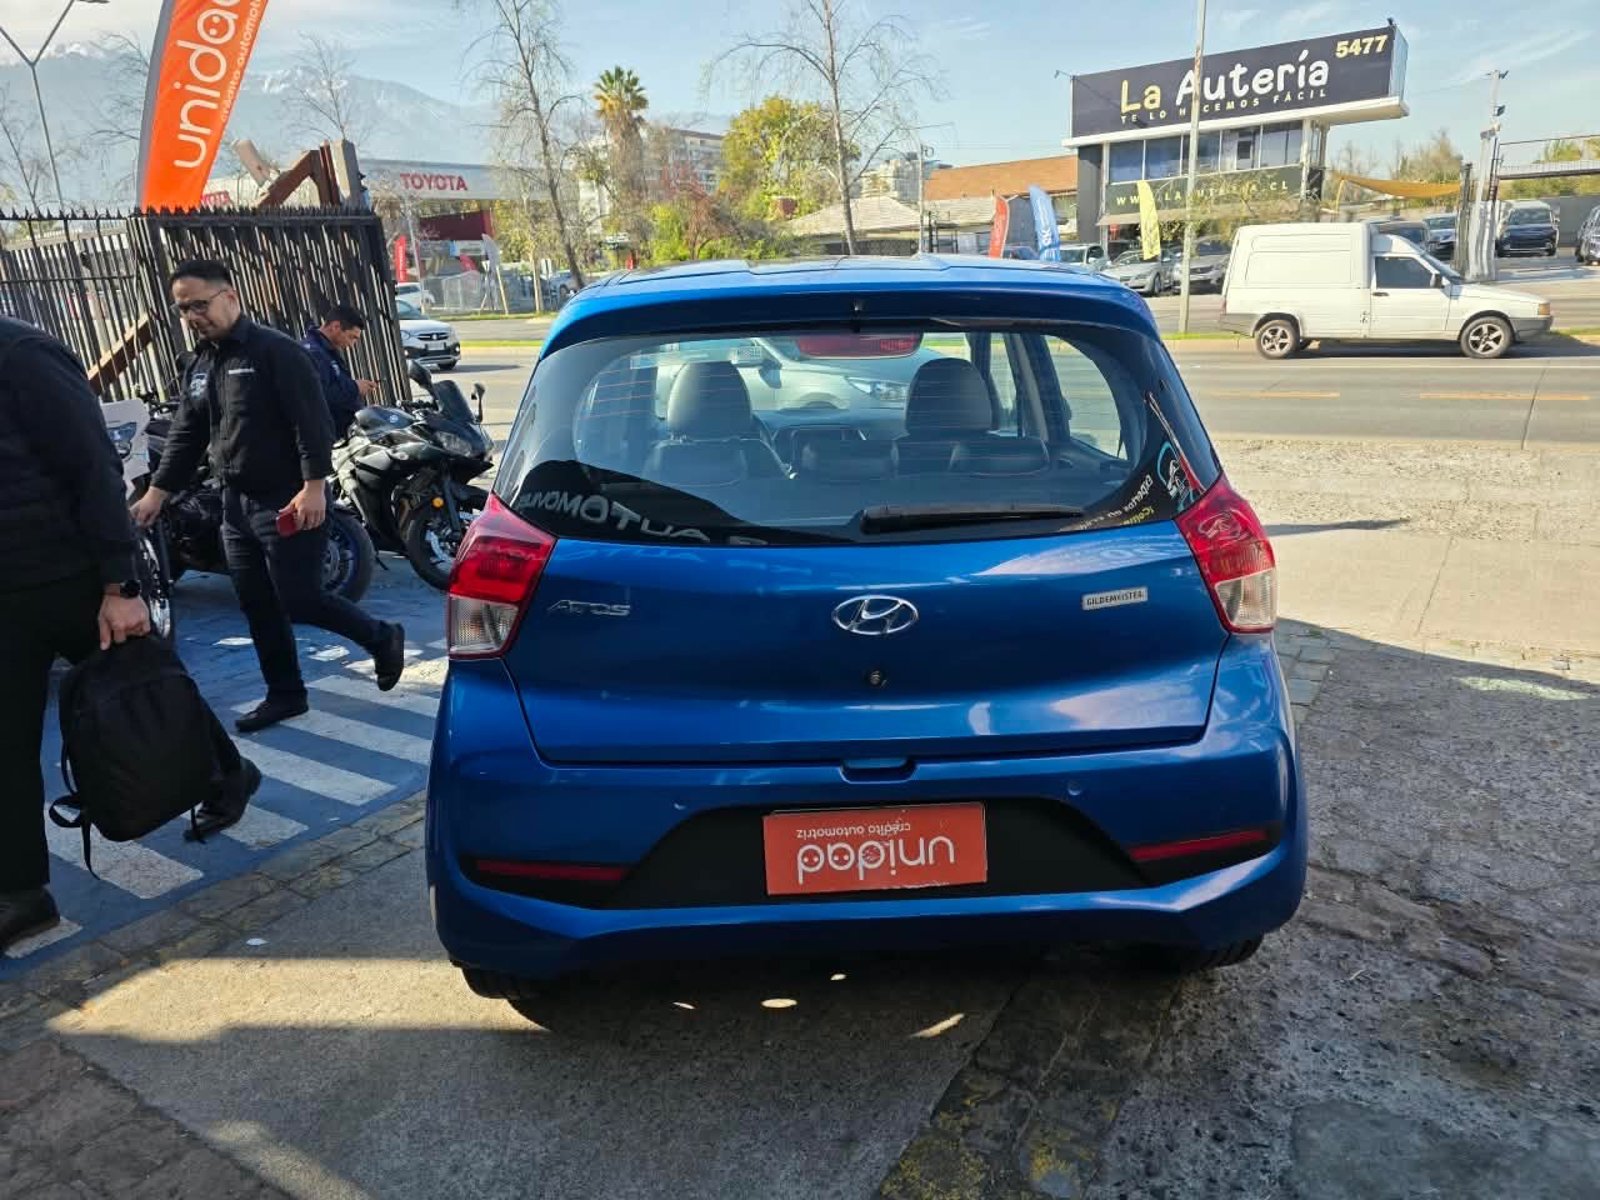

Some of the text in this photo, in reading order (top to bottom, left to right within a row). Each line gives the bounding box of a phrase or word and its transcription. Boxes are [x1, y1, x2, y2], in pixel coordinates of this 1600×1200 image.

[1335, 35, 1388, 59] 5477
[172, 0, 241, 168] unida
[1120, 49, 1329, 113] La Autería
[1120, 87, 1327, 124] TE LO HCEMOS FÁCIL
[400, 173, 467, 191] TOYOTA
[1086, 590, 1144, 606] GILDEMEISTER
[796, 824, 864, 840] automotriz
[797, 836, 955, 885] unidad
